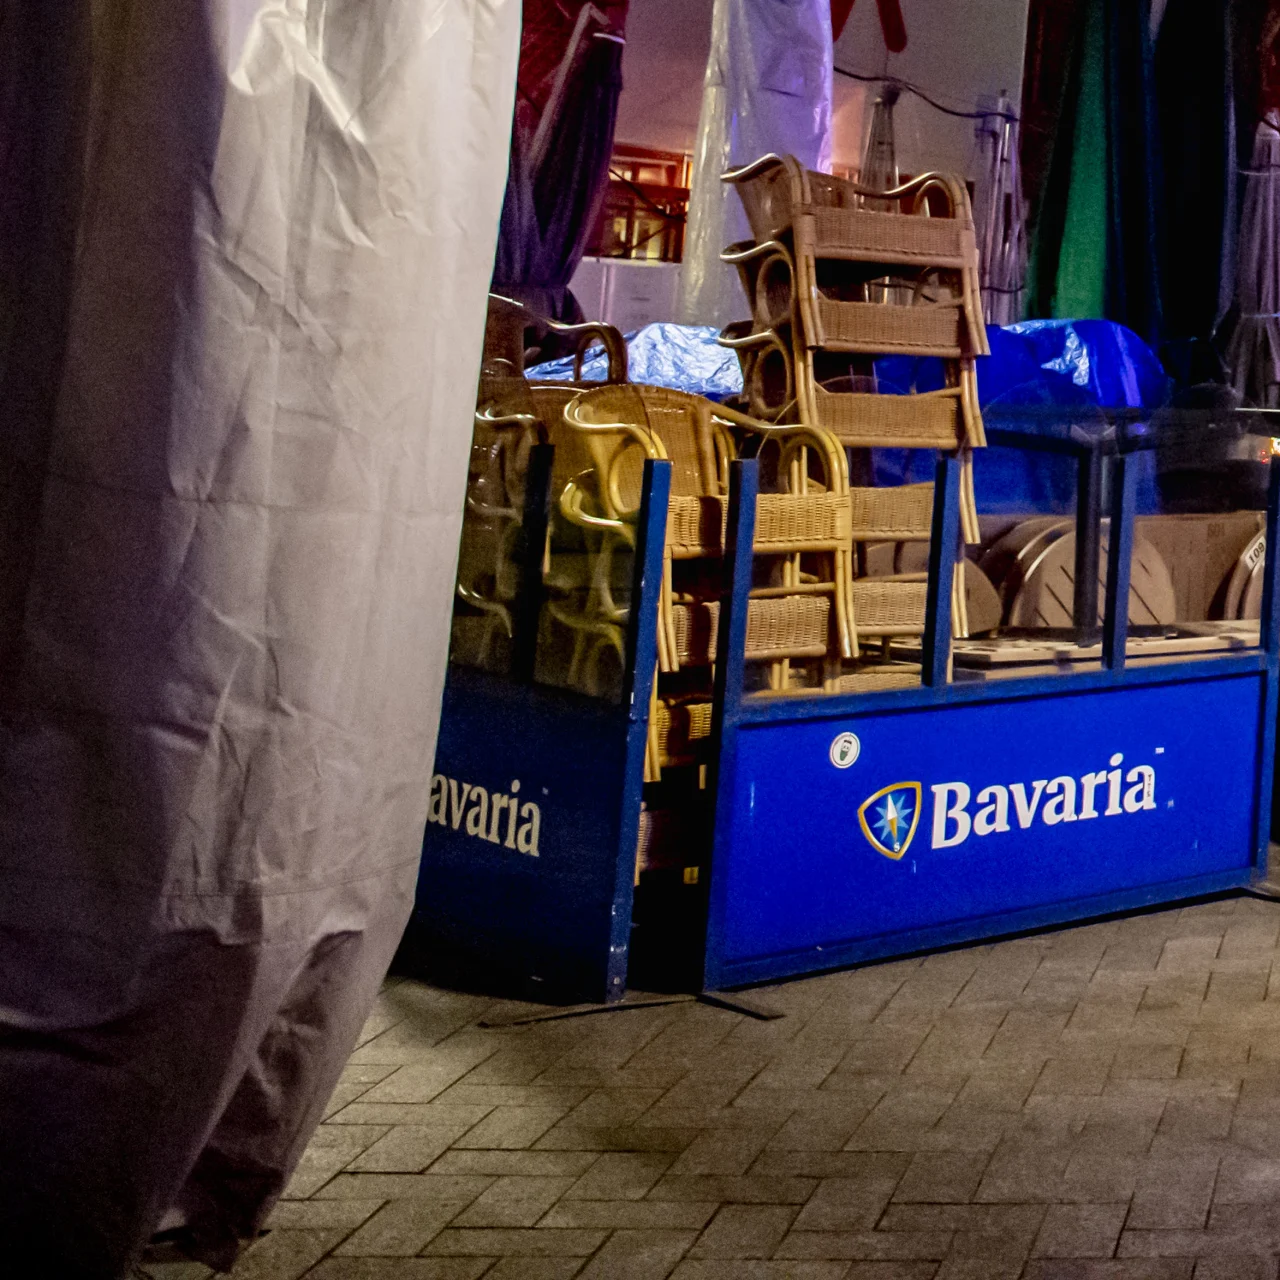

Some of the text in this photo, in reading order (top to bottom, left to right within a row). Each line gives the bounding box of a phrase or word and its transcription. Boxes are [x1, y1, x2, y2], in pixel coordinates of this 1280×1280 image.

[1248, 542, 1265, 564] 109
[427, 774, 541, 858] avaria
[931, 753, 1158, 851] Bavaria
